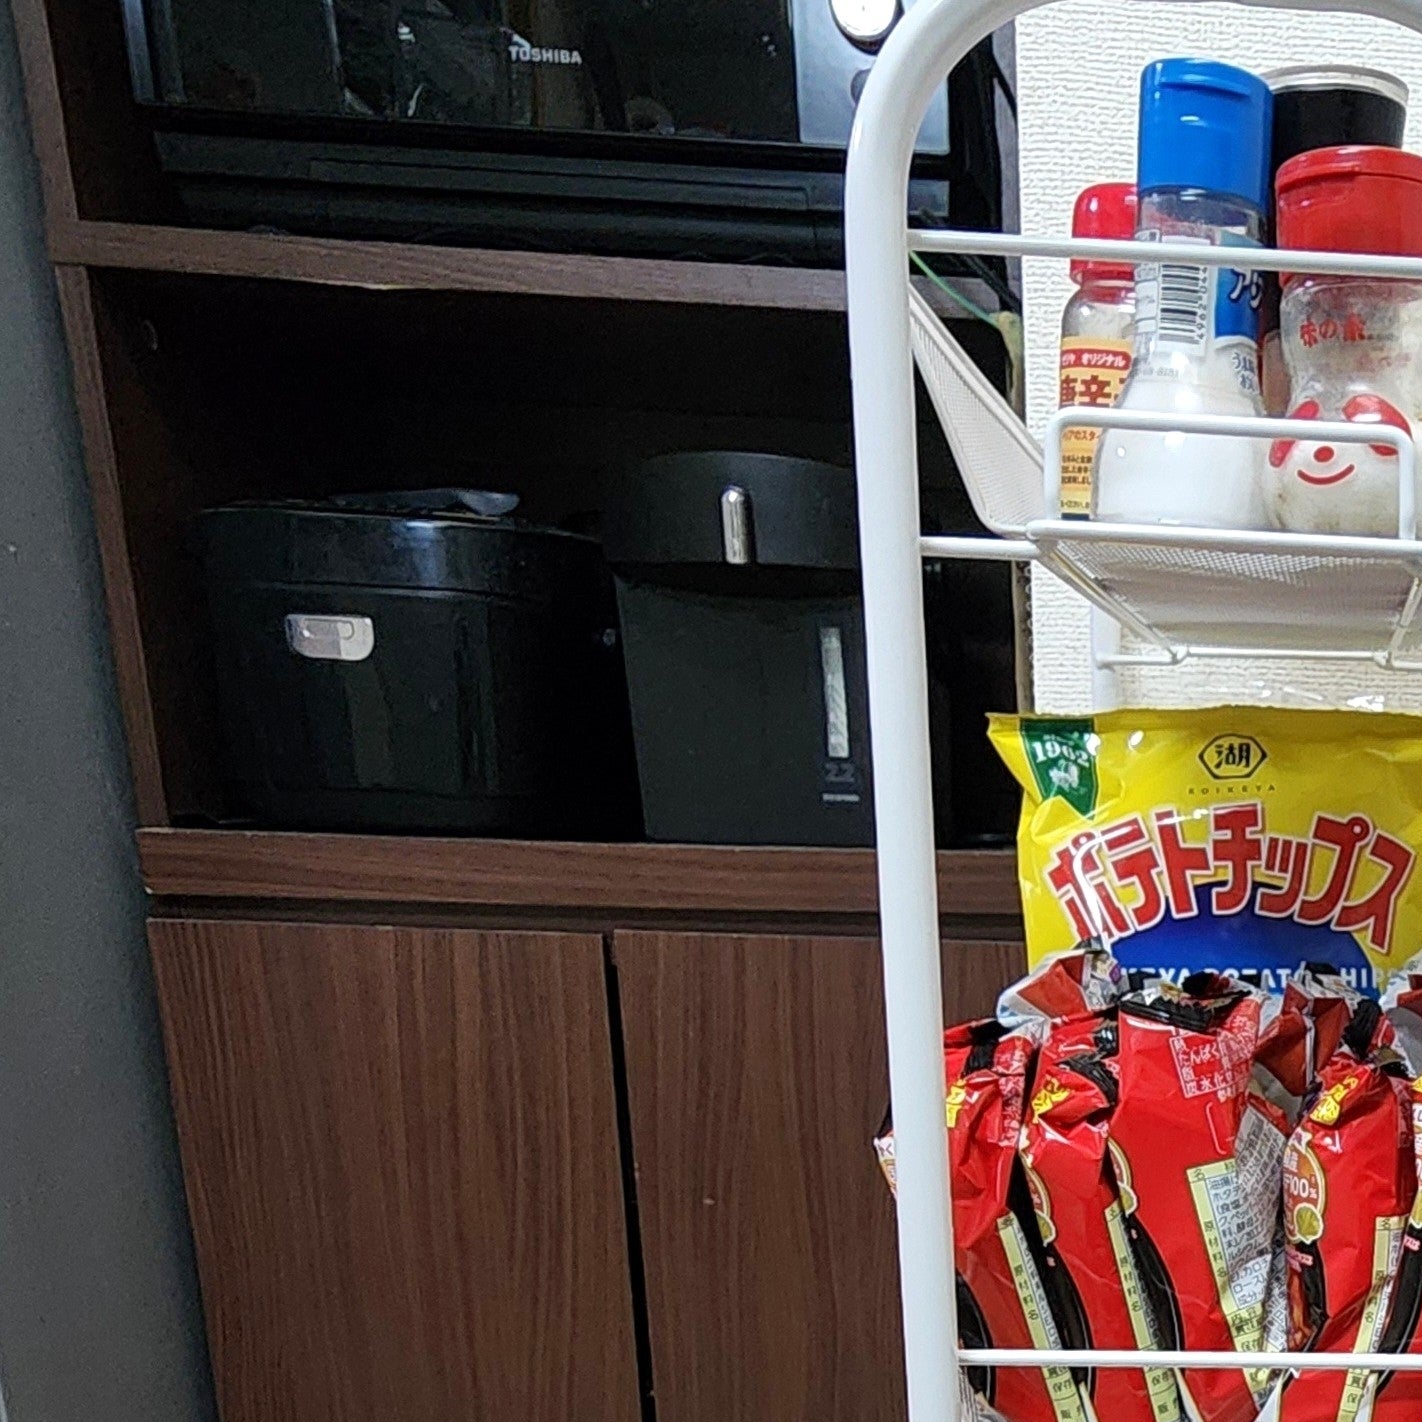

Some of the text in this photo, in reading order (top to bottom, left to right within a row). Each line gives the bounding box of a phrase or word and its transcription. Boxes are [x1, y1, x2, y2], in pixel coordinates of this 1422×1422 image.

[508, 46, 582, 65] TOSHIBA
[1214, 742, 1251, 770] 湖
[1188, 784, 1276, 795] KOIKEYA
[1047, 803, 1415, 954] ポテトチップス
